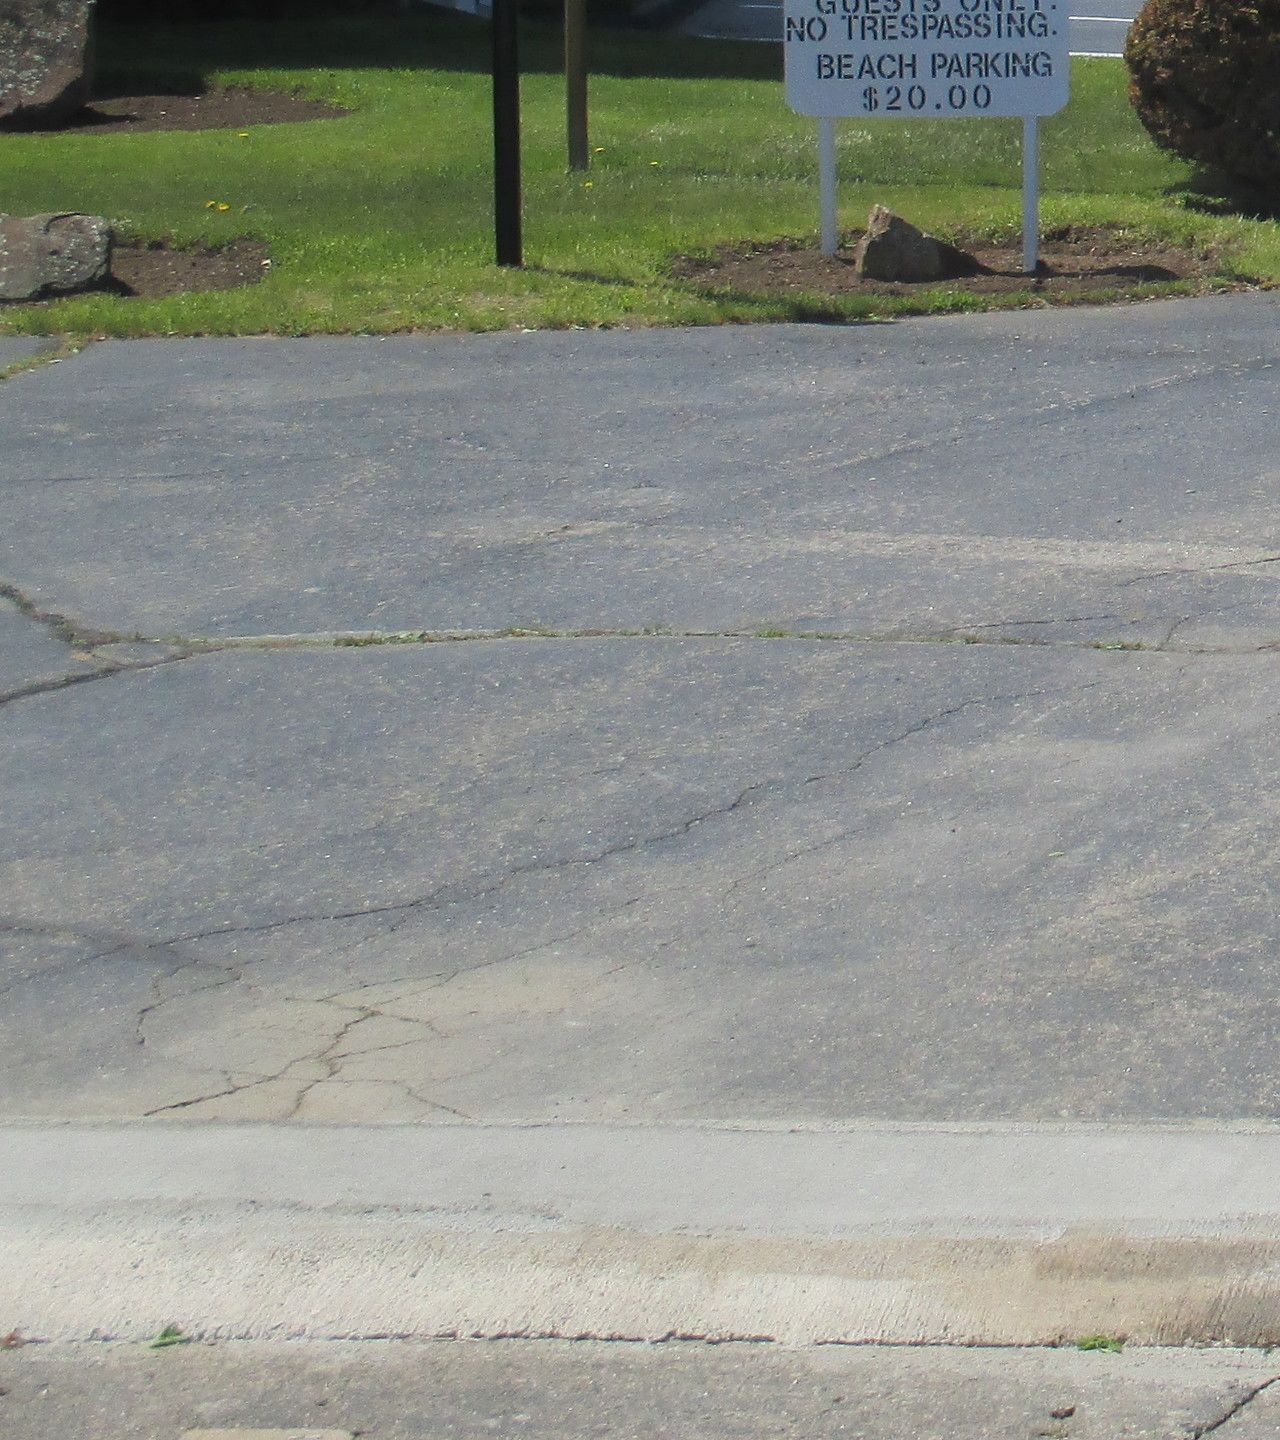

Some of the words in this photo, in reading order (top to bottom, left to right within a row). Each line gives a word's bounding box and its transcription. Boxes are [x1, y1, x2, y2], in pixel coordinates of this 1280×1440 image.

[786, 16, 827, 42] NO
[841, 11, 1058, 41] TRESPASSING.
[817, 53, 917, 80] BEACH
[931, 51, 1053, 78] PARKING
[862, 84, 992, 112] $20.00
